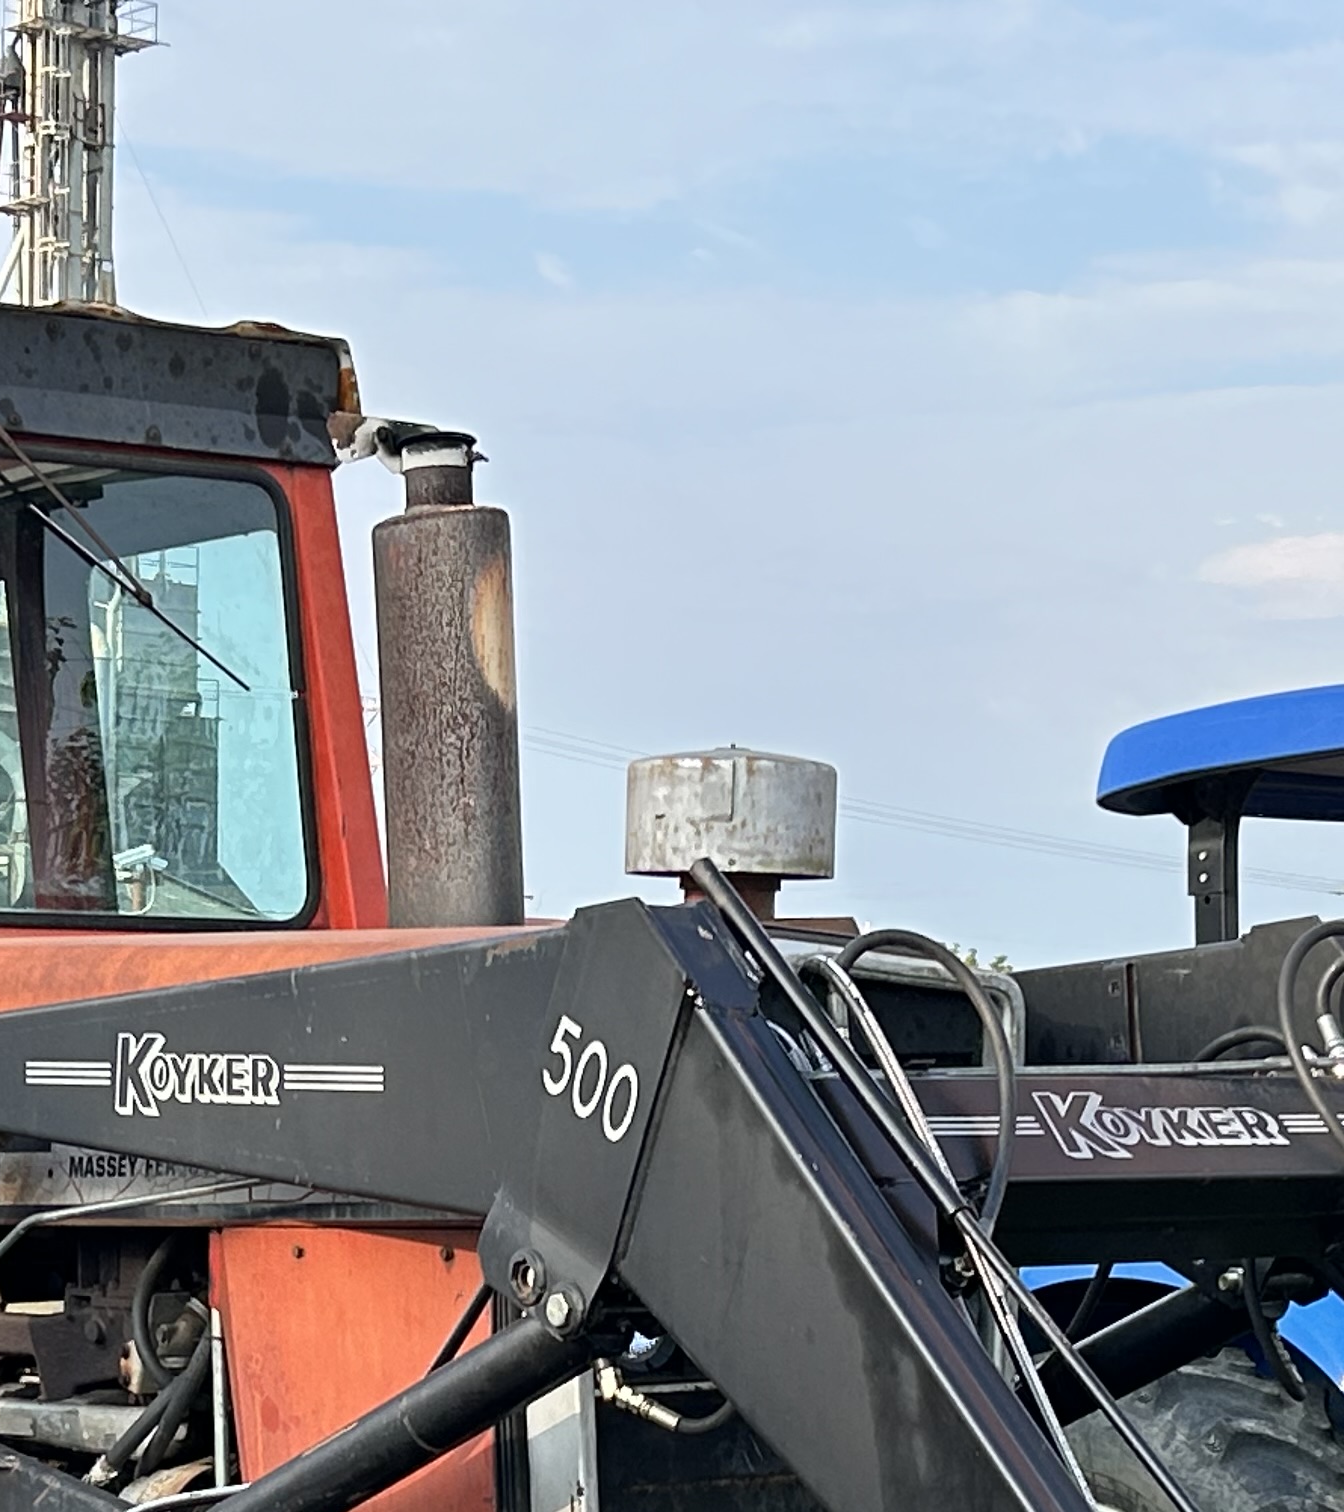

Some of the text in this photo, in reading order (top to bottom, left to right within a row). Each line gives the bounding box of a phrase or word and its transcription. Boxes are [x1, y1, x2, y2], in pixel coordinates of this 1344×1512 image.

[113, 1032, 281, 1117] KOYKER
[541, 1014, 640, 1143] 500
[1030, 1090, 1290, 1160] KOYKER
[68, 1155, 138, 1178] MASSEY
